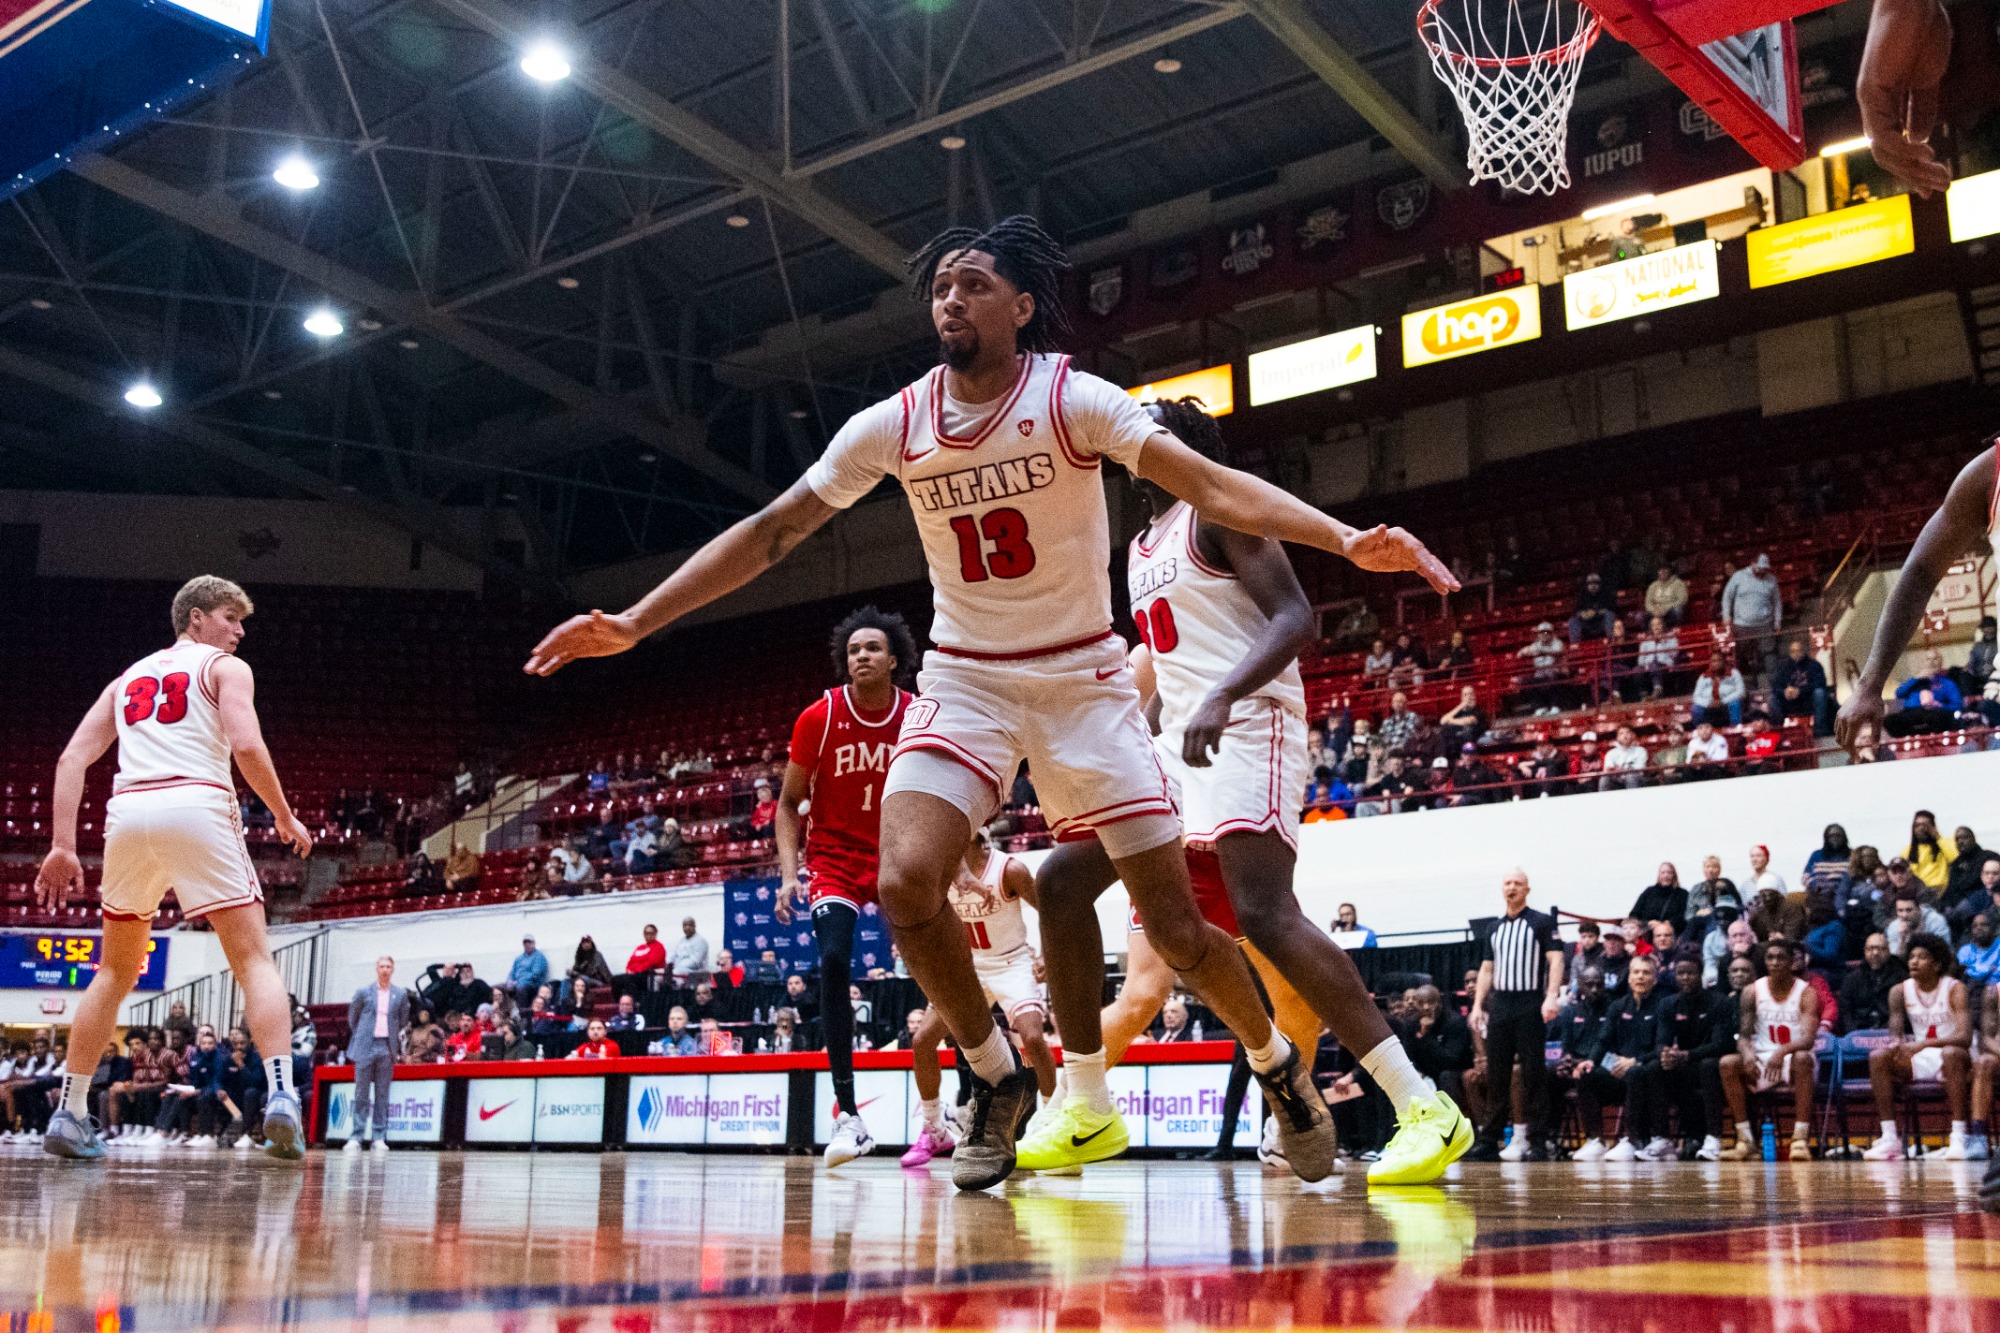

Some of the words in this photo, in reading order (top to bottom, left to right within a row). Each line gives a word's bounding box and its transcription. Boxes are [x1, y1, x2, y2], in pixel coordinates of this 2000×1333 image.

[1584, 142, 1643, 177] IUPUI
[1625, 250, 1705, 288] NATIONAL
[1437, 302, 1509, 346] hap
[910, 453, 1055, 511] TITANS
[949, 507, 1036, 583] 13
[124, 672, 190, 726] 33
[834, 741, 896, 777] RM
[861, 783, 873, 811] 1
[37, 938, 94, 961] 9:52
[405, 1098, 434, 1118] First
[665, 1095, 740, 1122] Michigan
[743, 1095, 780, 1117] First
[720, 1120, 750, 1132] CREDIT
[1167, 1120, 1208, 1133] CREDIT
